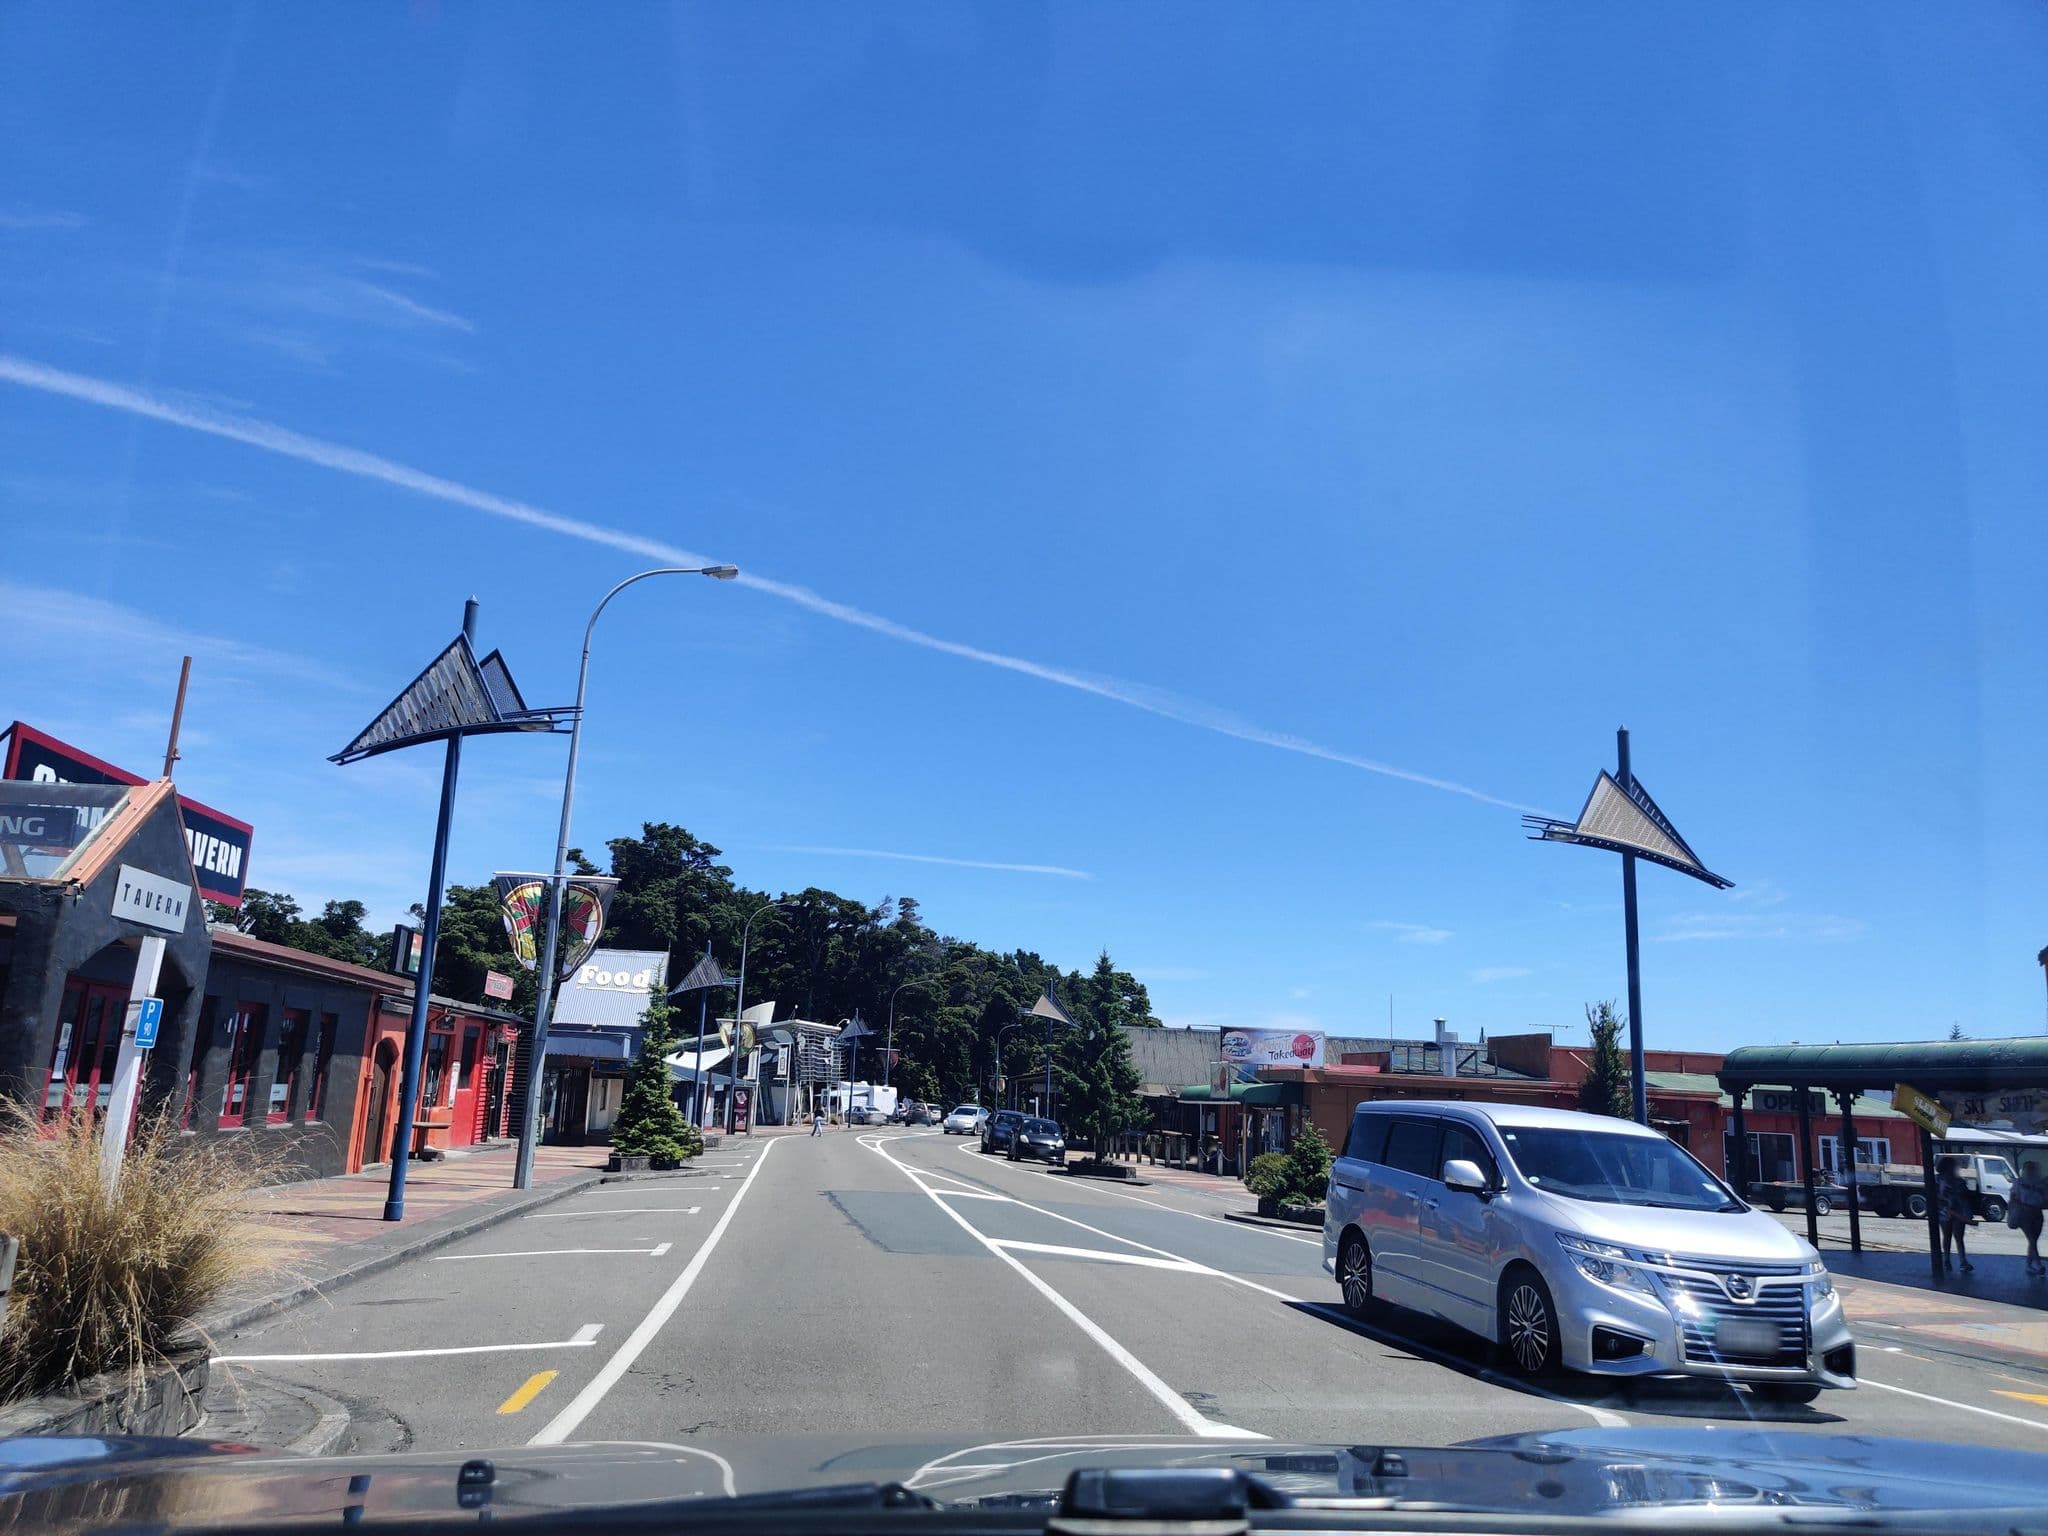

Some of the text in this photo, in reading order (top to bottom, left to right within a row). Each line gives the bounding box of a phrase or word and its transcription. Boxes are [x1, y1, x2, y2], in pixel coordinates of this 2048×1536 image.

[123, 883, 183, 918] TAVERN
[577, 965, 651, 988] Food
[146, 1001, 156, 1019] P
[1268, 1047, 1314, 1061] Takeaway
